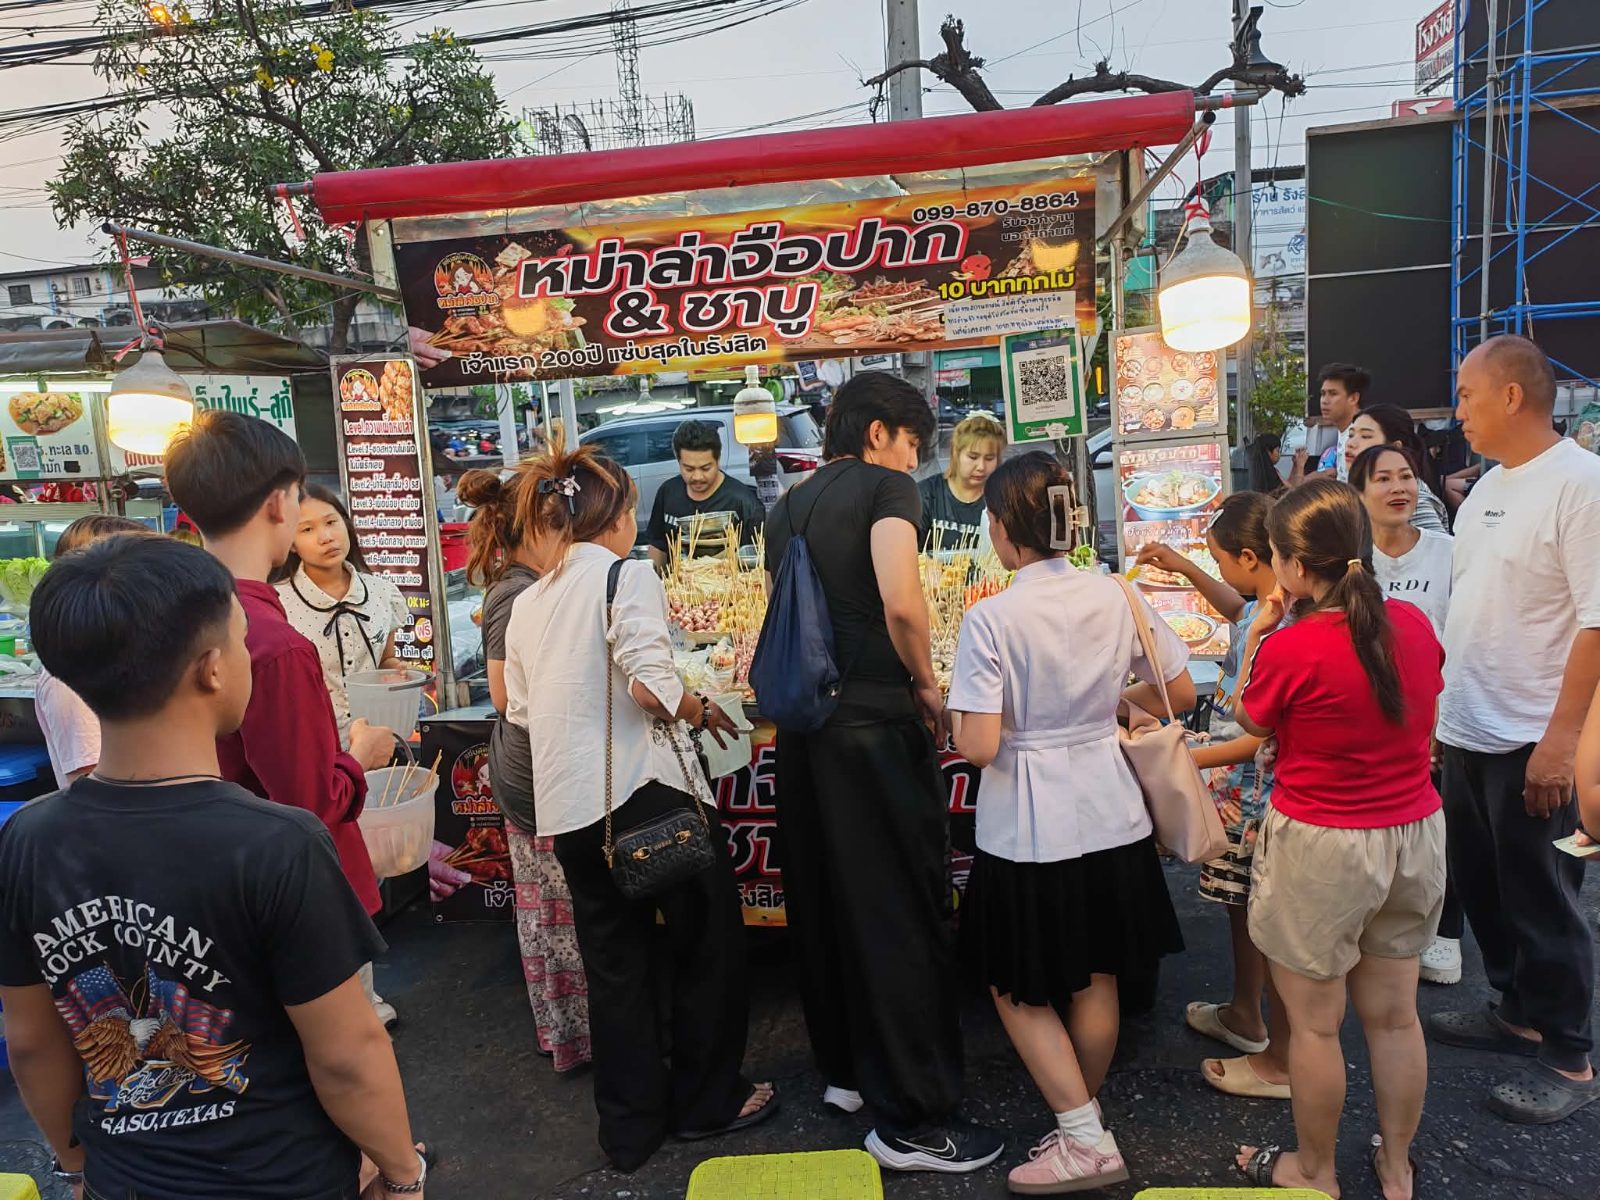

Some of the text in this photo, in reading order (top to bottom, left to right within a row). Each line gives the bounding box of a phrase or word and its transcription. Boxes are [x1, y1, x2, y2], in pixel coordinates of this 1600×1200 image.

[913, 192, 1077, 222] 099-870-8864
[1002, 212, 1075, 229] รับออกงาน
[1001, 225, 1075, 242] นอกสถานที่
[518, 218, 962, 297] หม่าล่าจือปาก
[938, 266, 1076, 301] 10 บาททุกไม้
[606, 283, 817, 338] & ชาบู
[461, 334, 767, 376] เจ้าแรก 200ปี แซ่บสุดในรังสิต
[48, 445, 73, 456] ทะเล
[33, 895, 215, 959] AMERICAN
